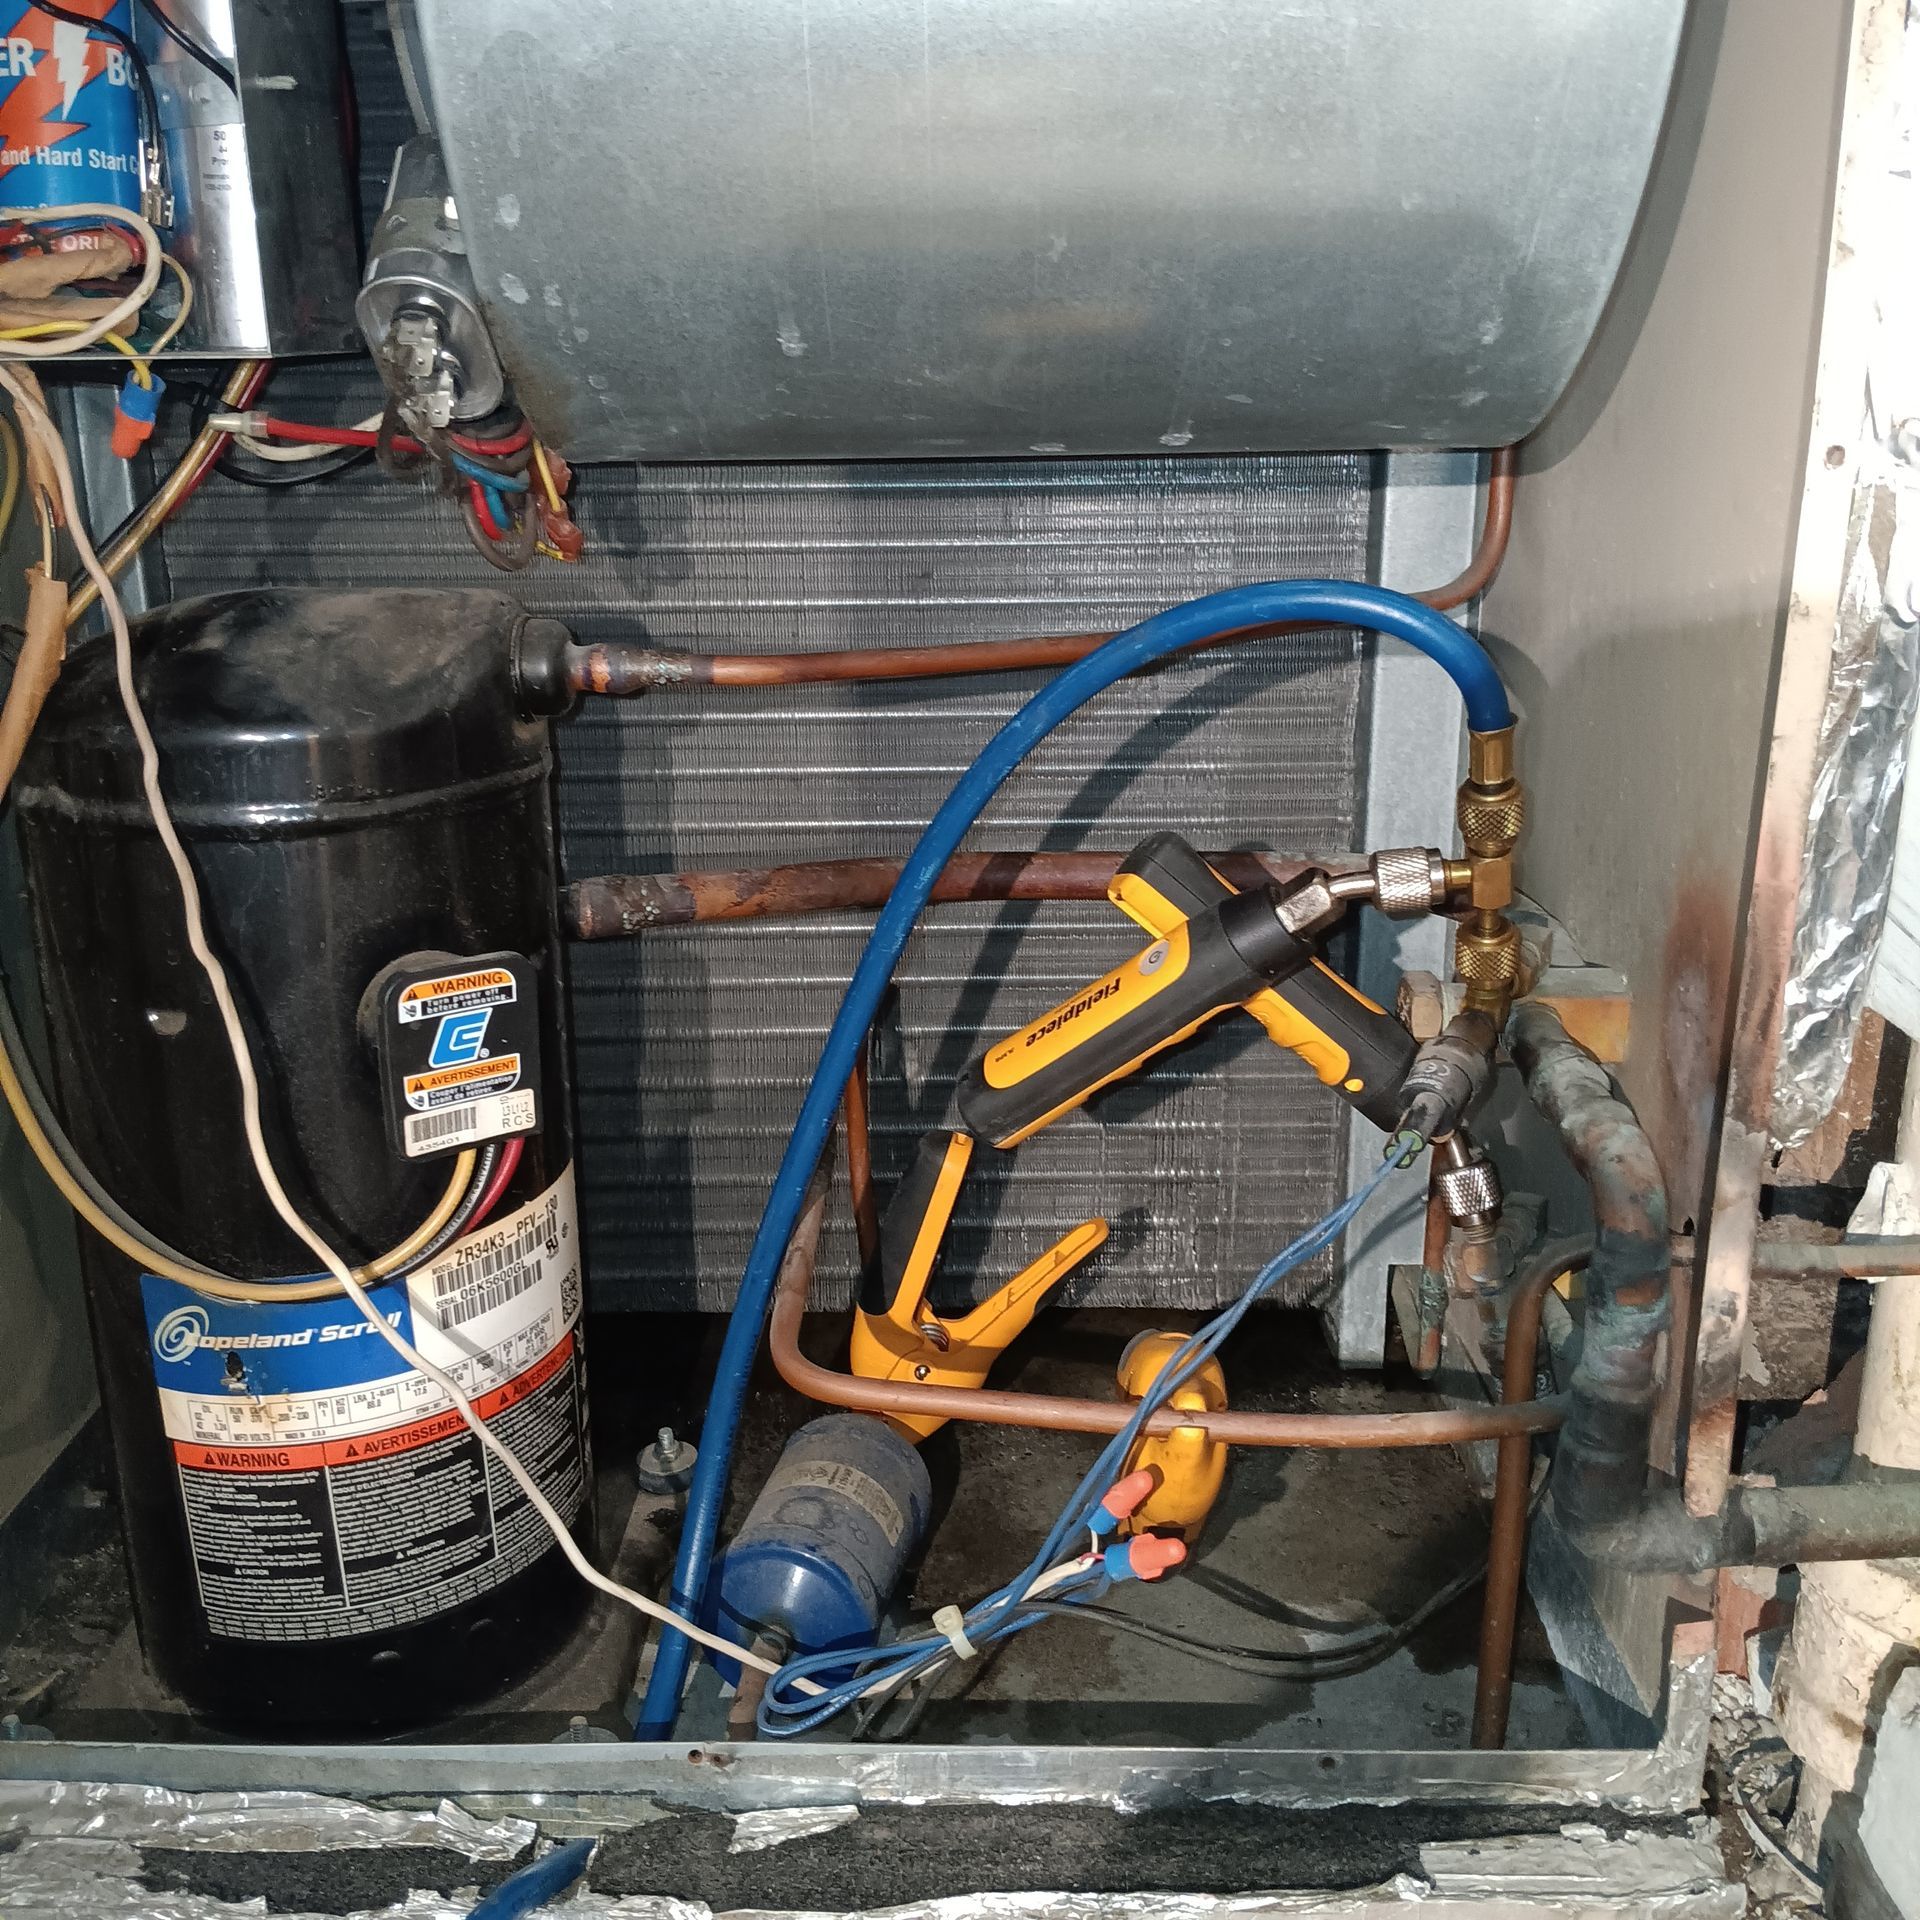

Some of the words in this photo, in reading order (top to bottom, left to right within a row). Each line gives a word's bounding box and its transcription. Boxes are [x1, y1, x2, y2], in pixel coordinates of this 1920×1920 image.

[1, 145, 30, 166] and
[36, 145, 83, 167] Hard
[88, 152, 127, 175] Start
[432, 972, 504, 994] WARNING
[427, 999, 451, 1008] Turn
[453, 993, 482, 1005] power
[484, 988, 499, 996] off
[427, 1003, 459, 1014] before
[1026, 977, 1121, 1047] Fieldpiece
[430, 1060, 516, 1086] AVERTISSEMENT
[429, 1086, 459, 1099] Couper
[453, 1091, 465, 1101] de
[436, 1295, 458, 1309] SERIAL
[363, 1412, 467, 1455] AVERTISSEMEN
[217, 1452, 290, 1467] WARNING
